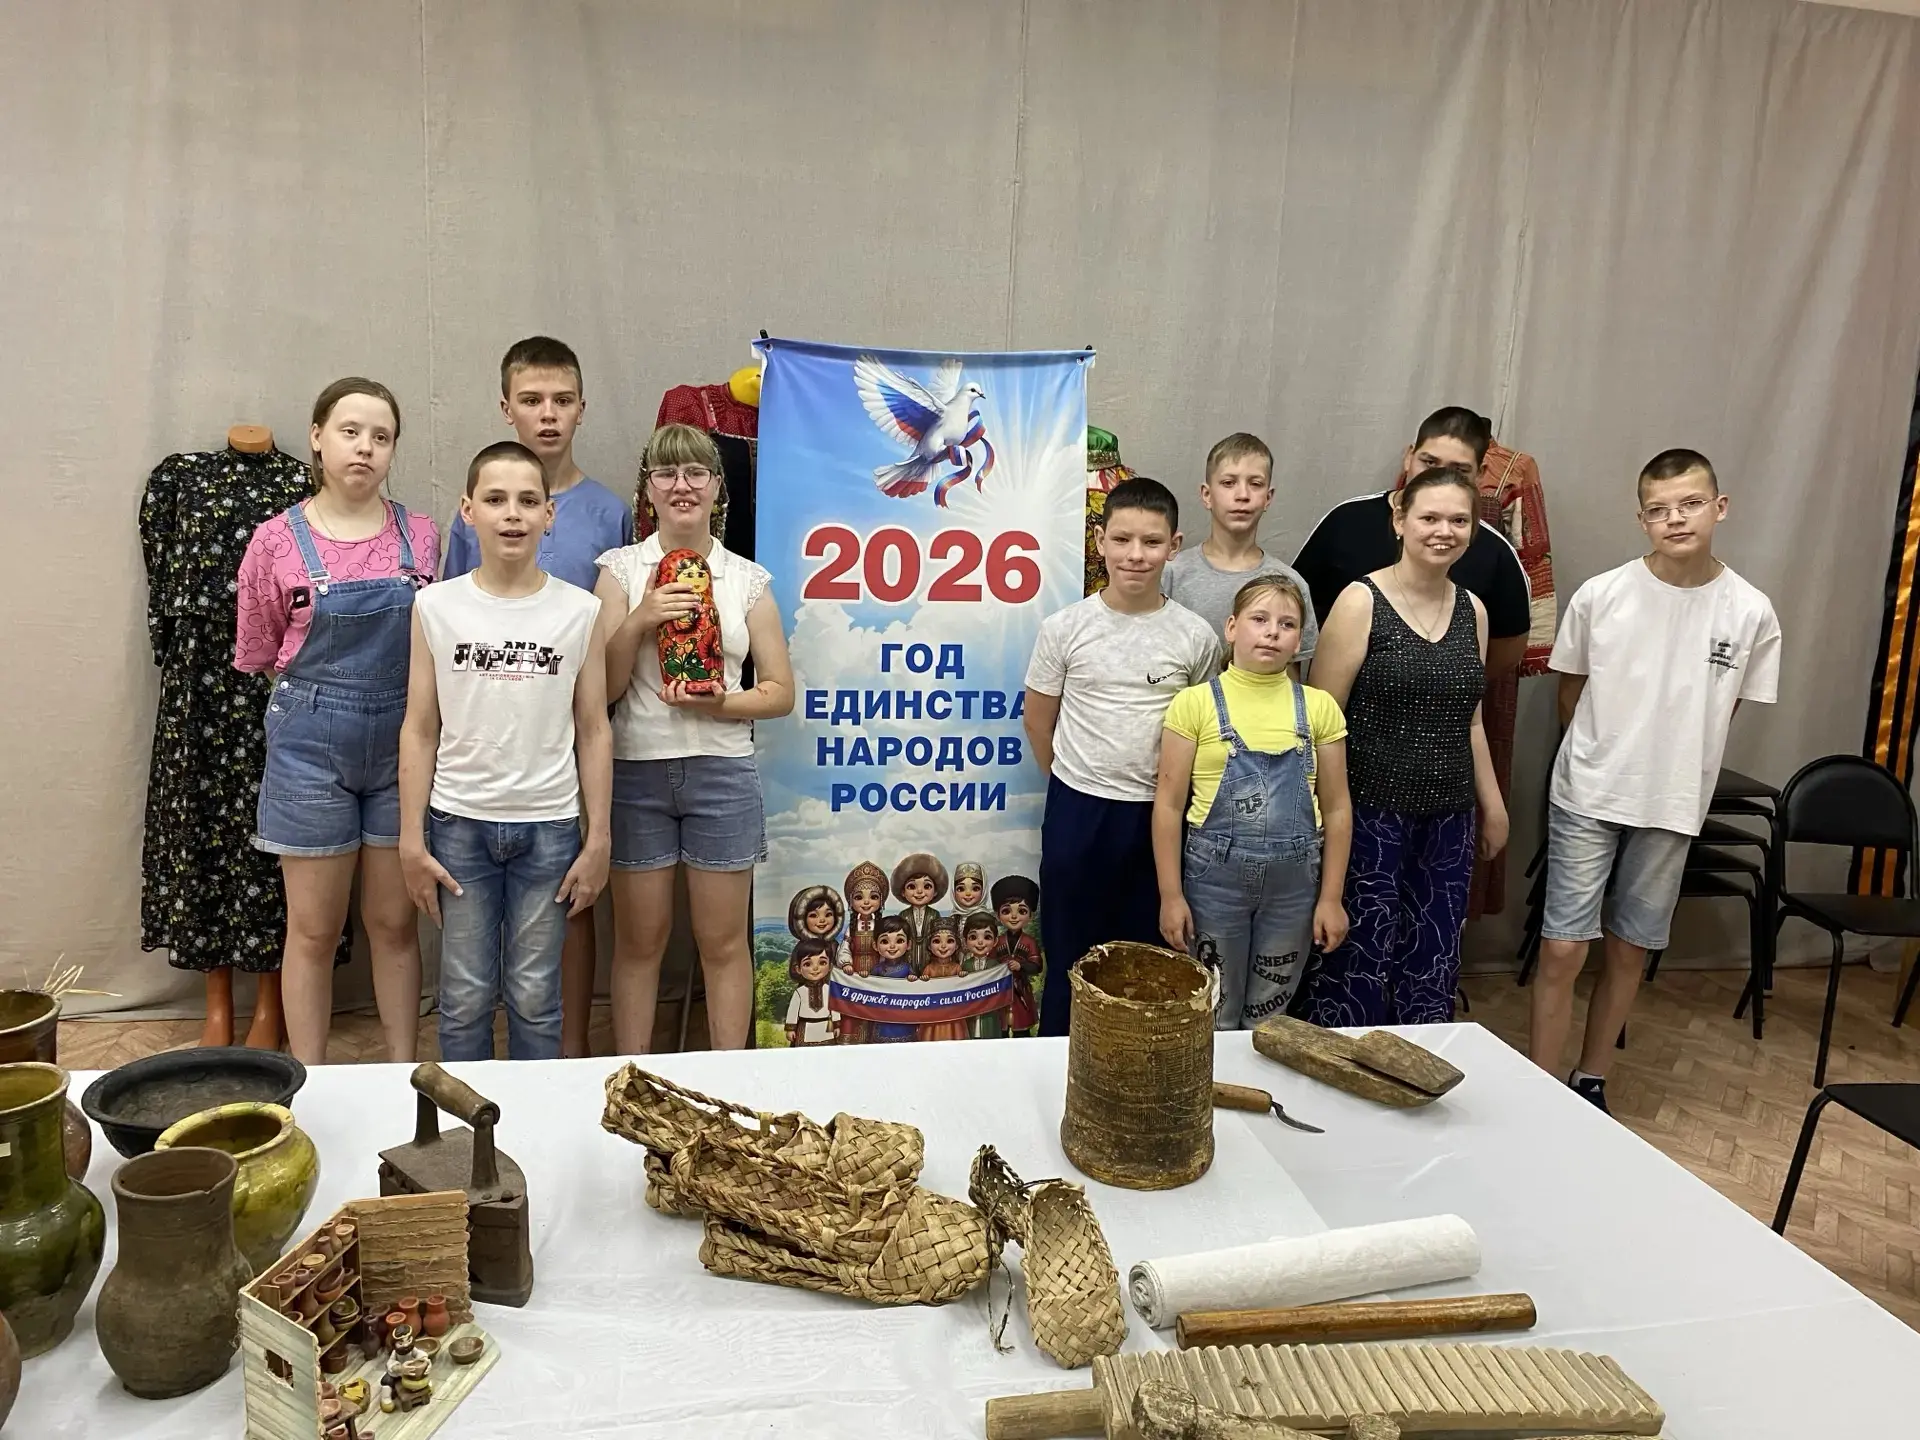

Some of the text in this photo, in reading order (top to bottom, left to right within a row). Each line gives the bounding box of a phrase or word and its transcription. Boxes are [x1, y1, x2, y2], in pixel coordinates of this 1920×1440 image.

[802, 525, 1042, 604] 2026
[503, 641, 537, 650] AND
[881, 643, 965, 679] ГОД
[816, 736, 1022, 772] НАРОДОВ
[831, 782, 1006, 812] РОССИИ
[841, 987, 850, 997] В
[850, 992, 889, 1006] дружбе
[890, 997, 931, 1009] народов
[939, 996, 963, 1006] сила
[964, 983, 1000, 1003] России!
[1243, 990, 1292, 1019] SCHOOL
